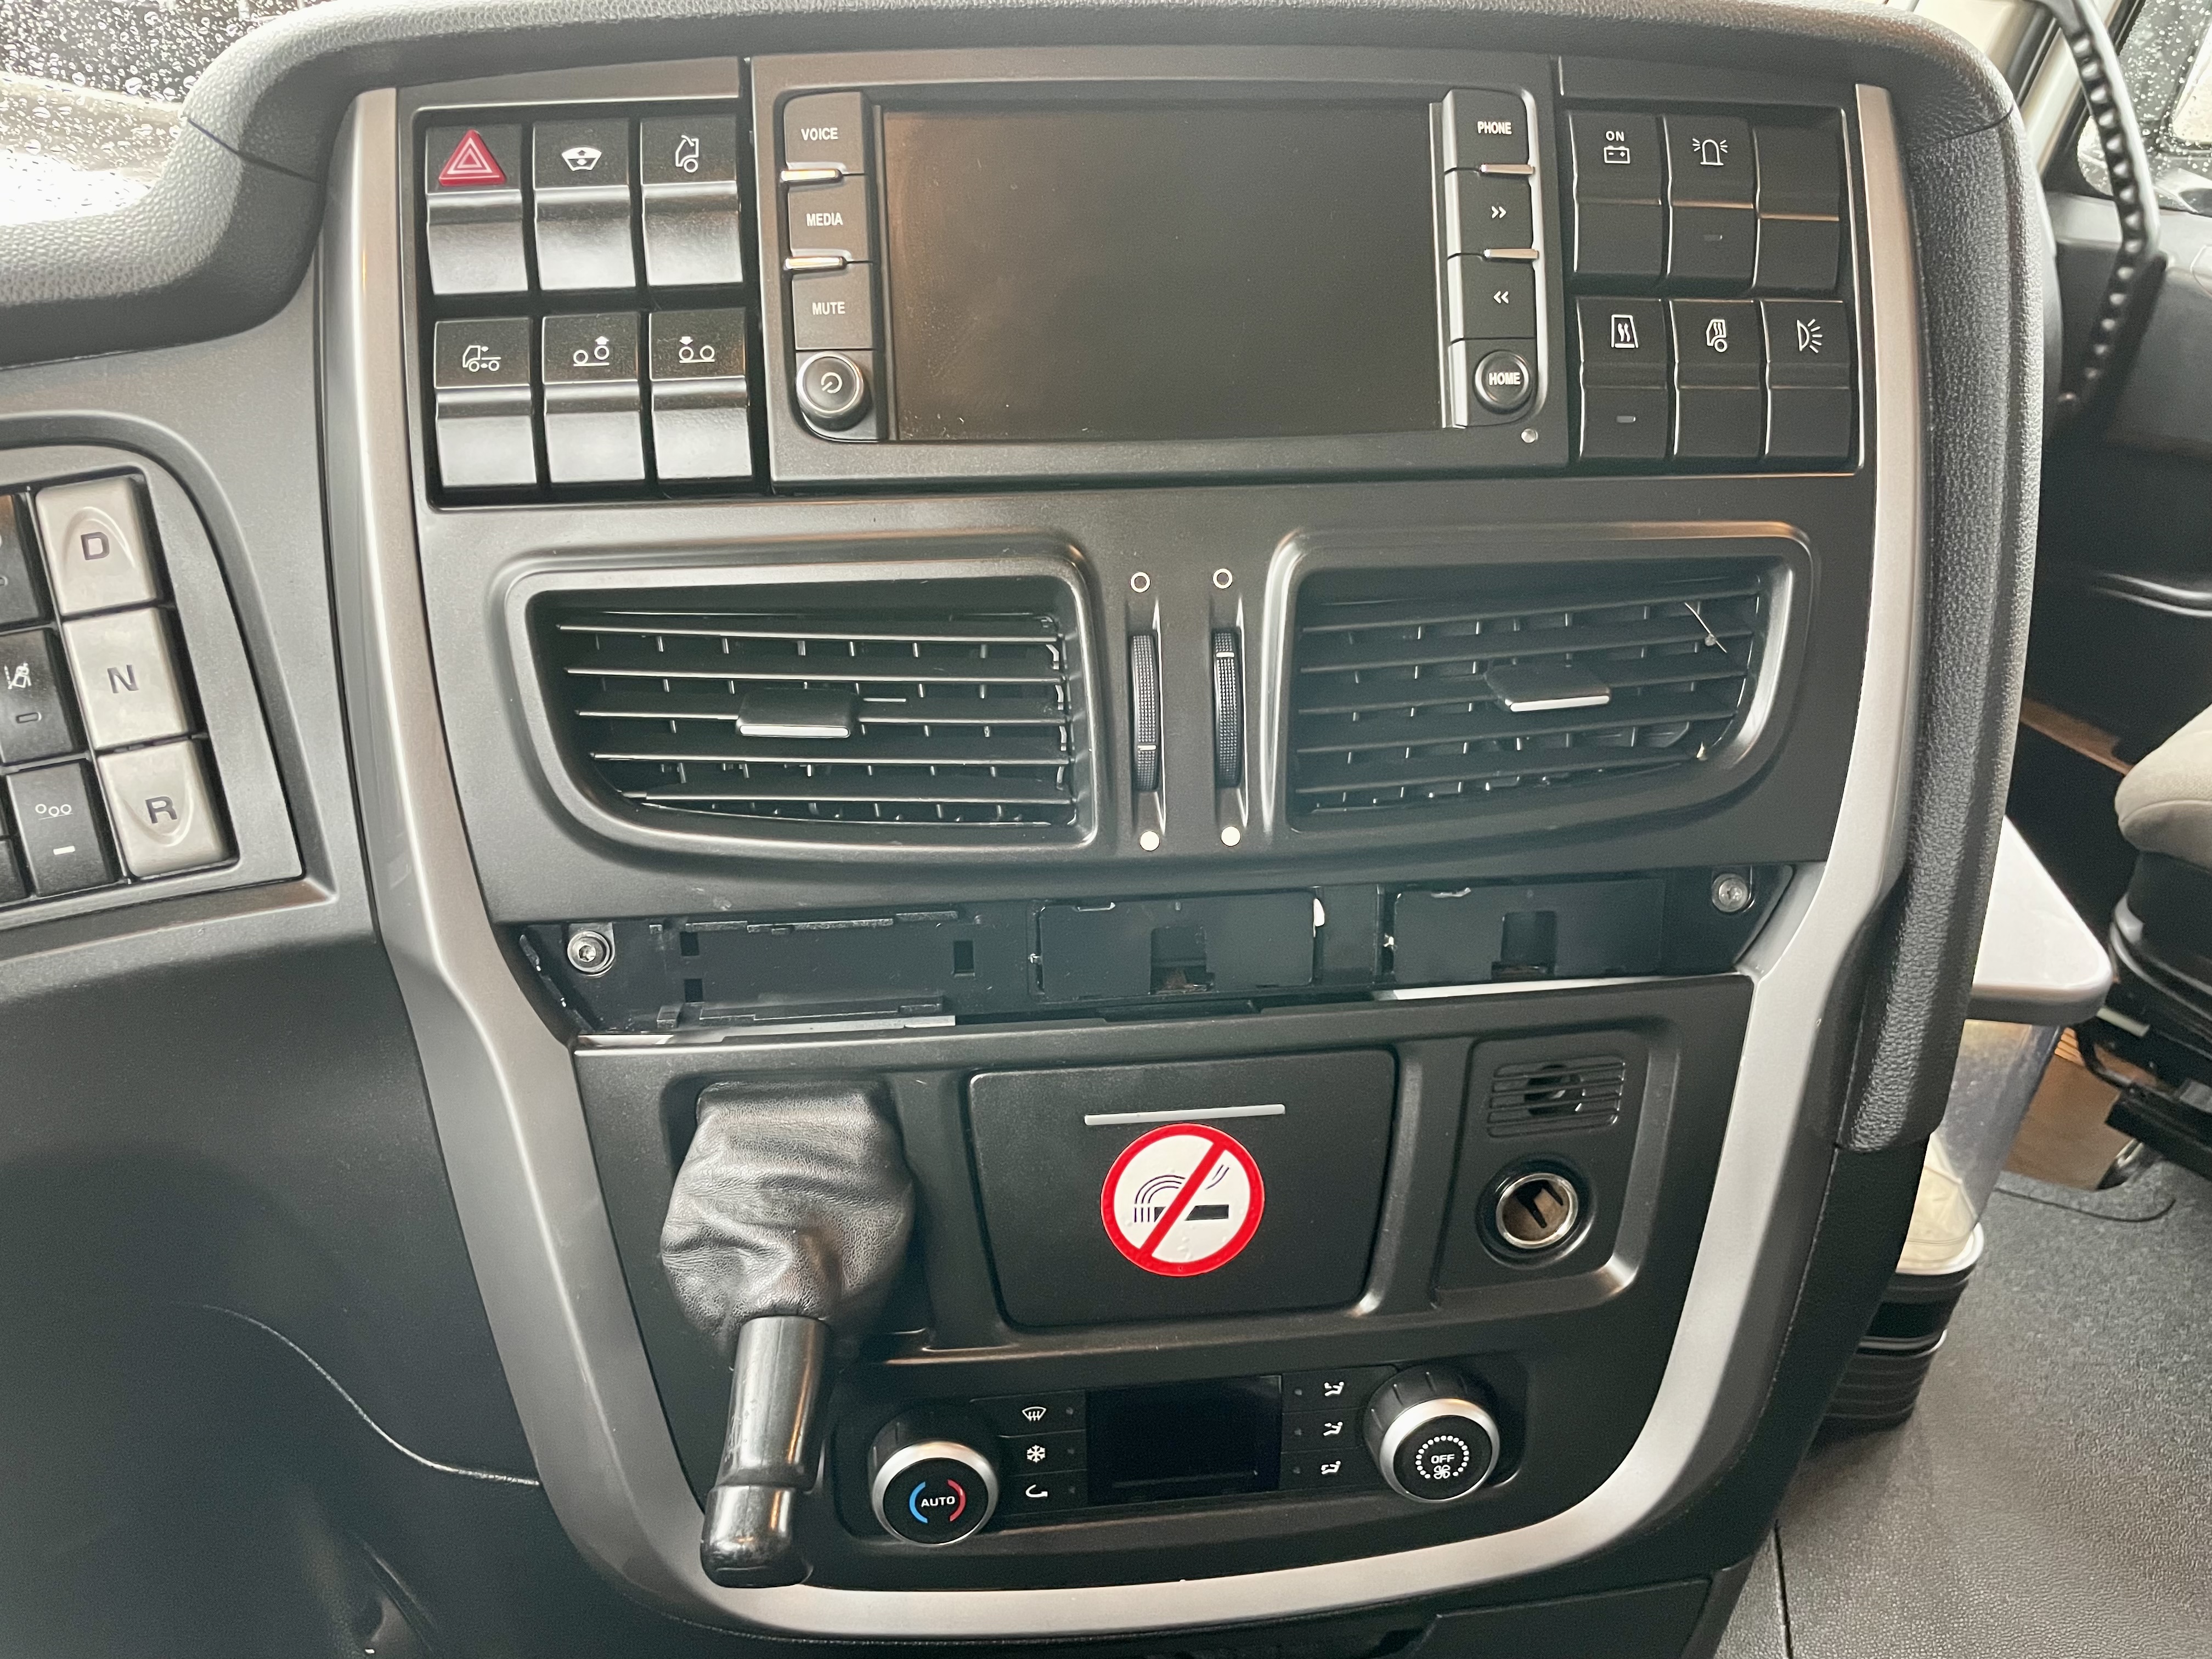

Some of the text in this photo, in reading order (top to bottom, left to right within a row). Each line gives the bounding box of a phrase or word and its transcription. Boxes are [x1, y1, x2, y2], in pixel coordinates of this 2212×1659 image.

[800, 127, 838, 141] VOICE
[1477, 121, 1513, 135] PHONE
[1606, 131, 1624, 142] ON
[806, 213, 844, 227] MEDIA
[812, 302, 845, 315] MUTE
[1488, 373, 1521, 386] HOME
[80, 531, 110, 561] D
[107, 664, 139, 693] N
[146, 795, 178, 825] R
[1431, 1453, 1455, 1464] OFF
[921, 1495, 955, 1508] AUTO
